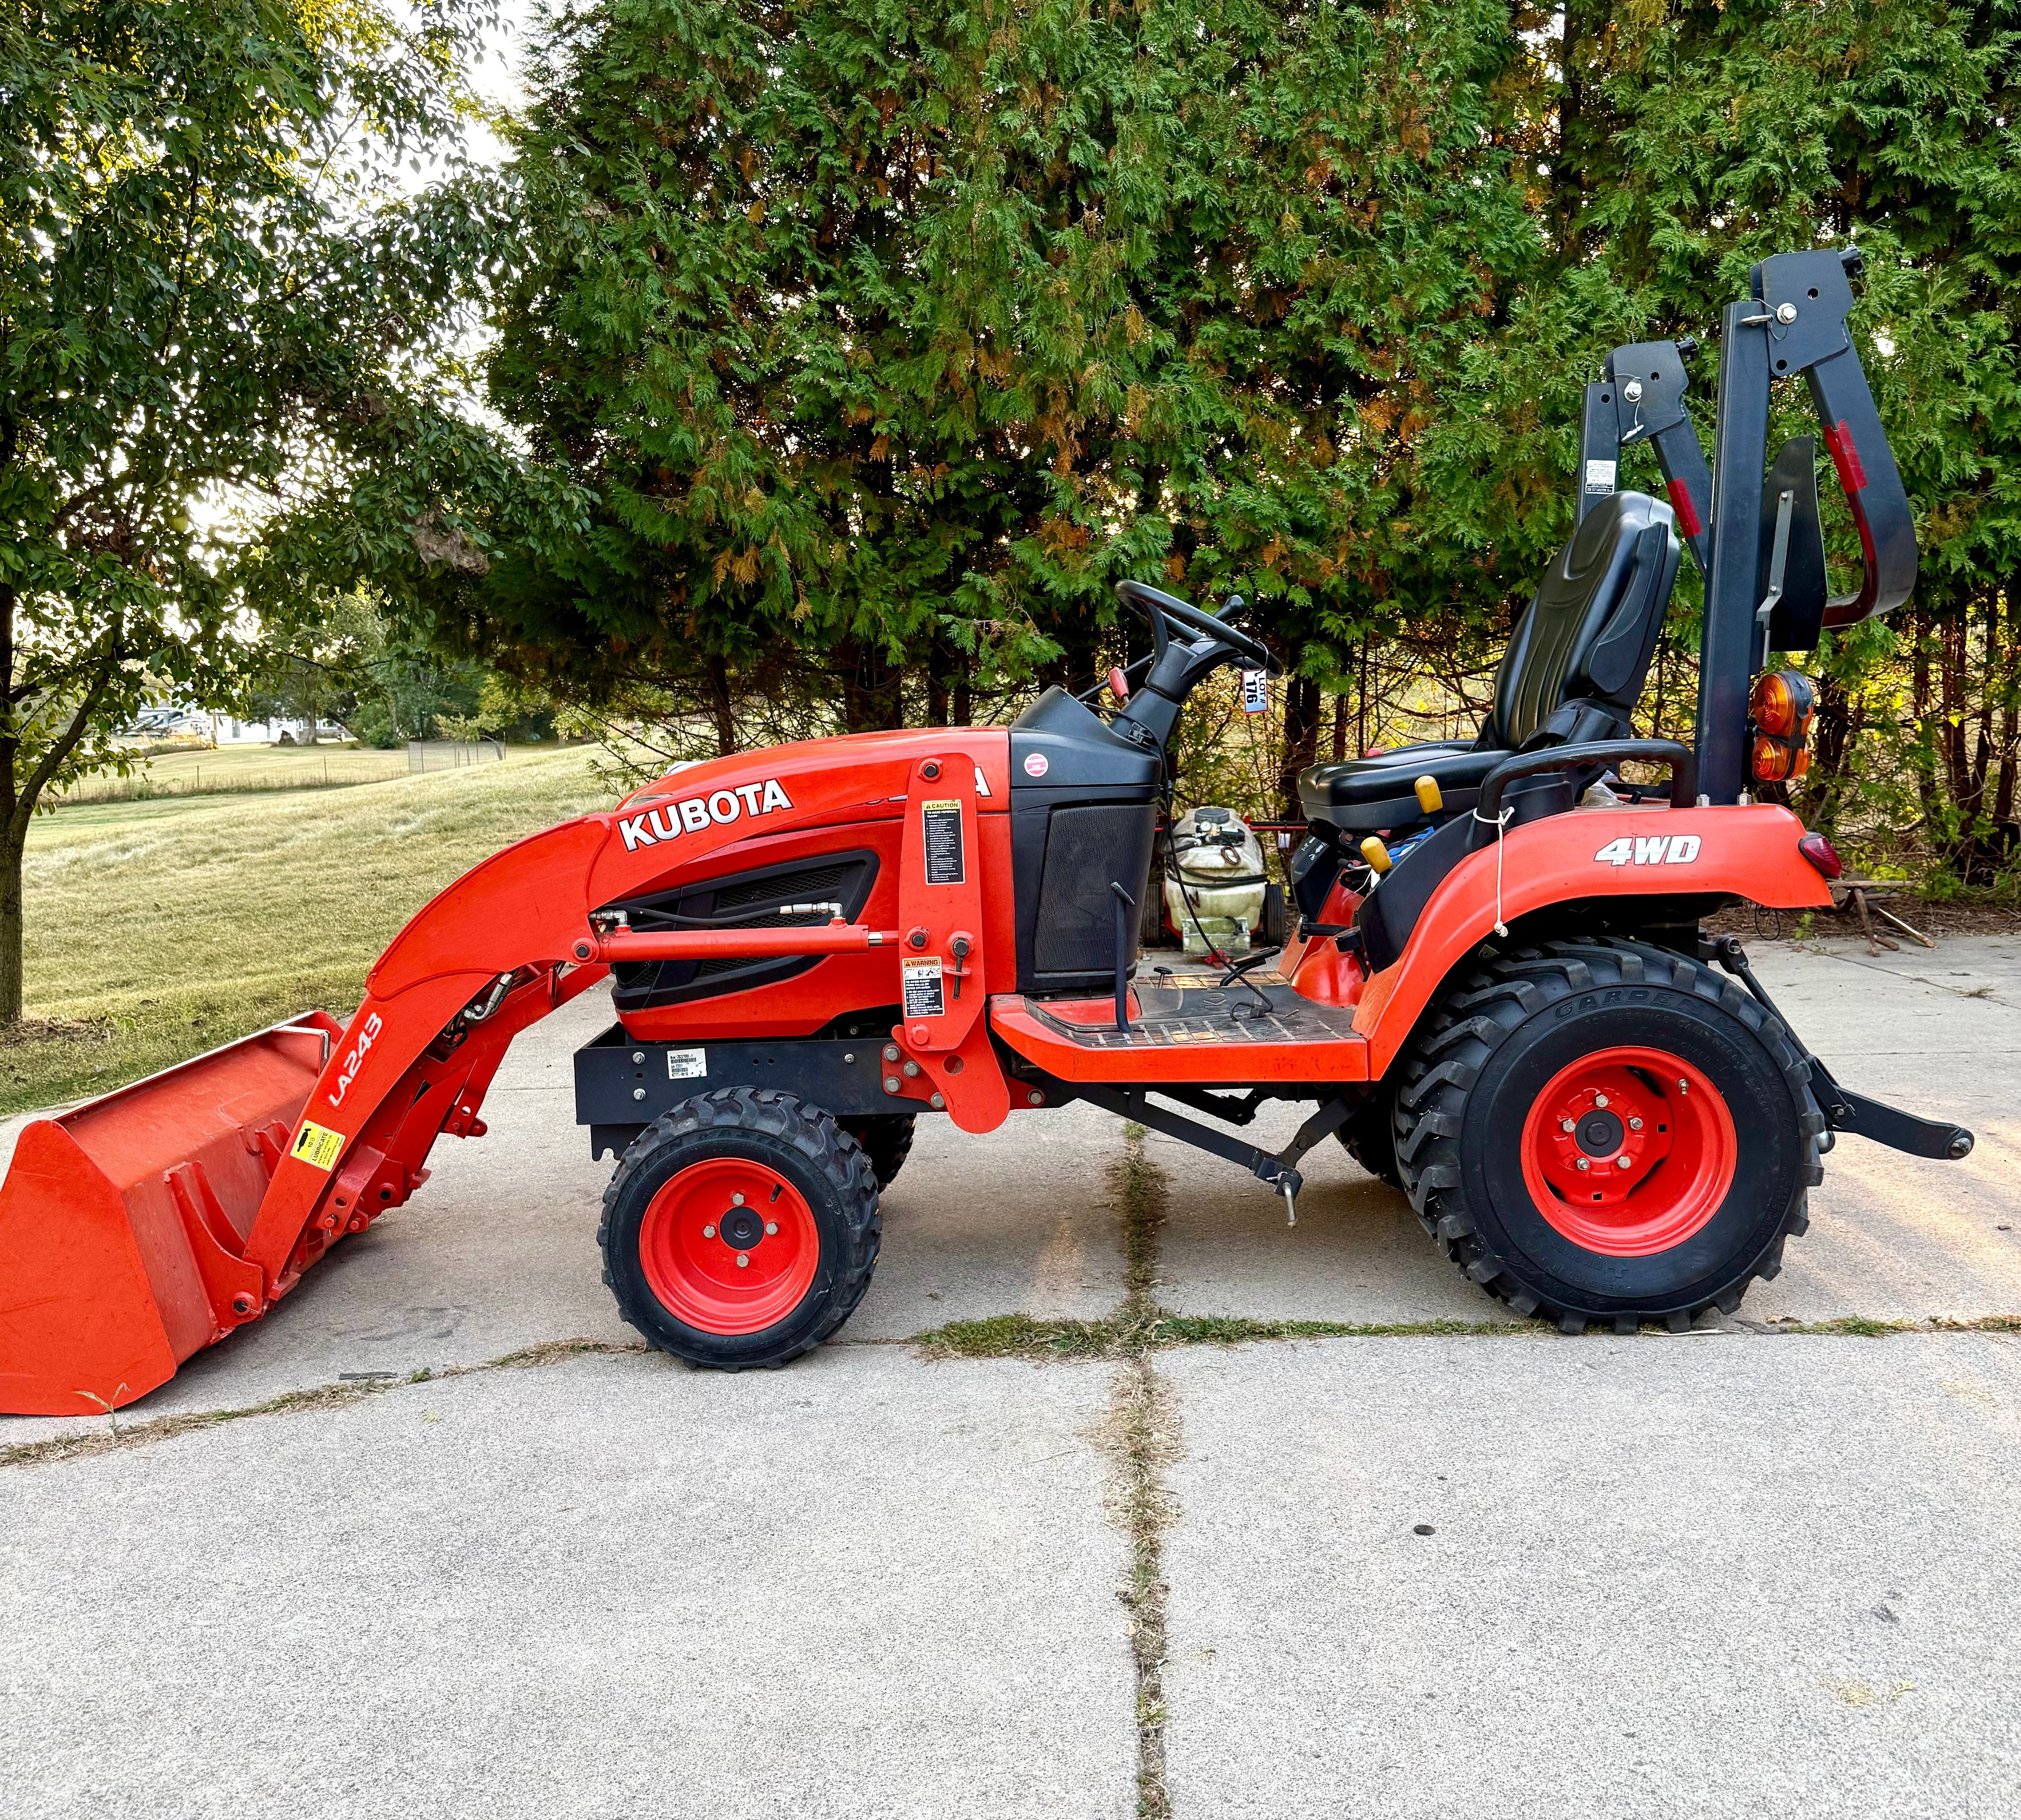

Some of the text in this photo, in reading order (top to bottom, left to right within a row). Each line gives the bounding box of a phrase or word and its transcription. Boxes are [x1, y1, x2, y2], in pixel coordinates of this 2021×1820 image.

[1246, 679, 1258, 704] 176
[618, 779, 794, 852] KUBOTA
[1594, 835, 1702, 866] 4WD
[1554, 990, 1704, 1018] GARDEN
[328, 1012, 382, 1107] LA243
[312, 1132, 328, 1161] LUBRICATE
